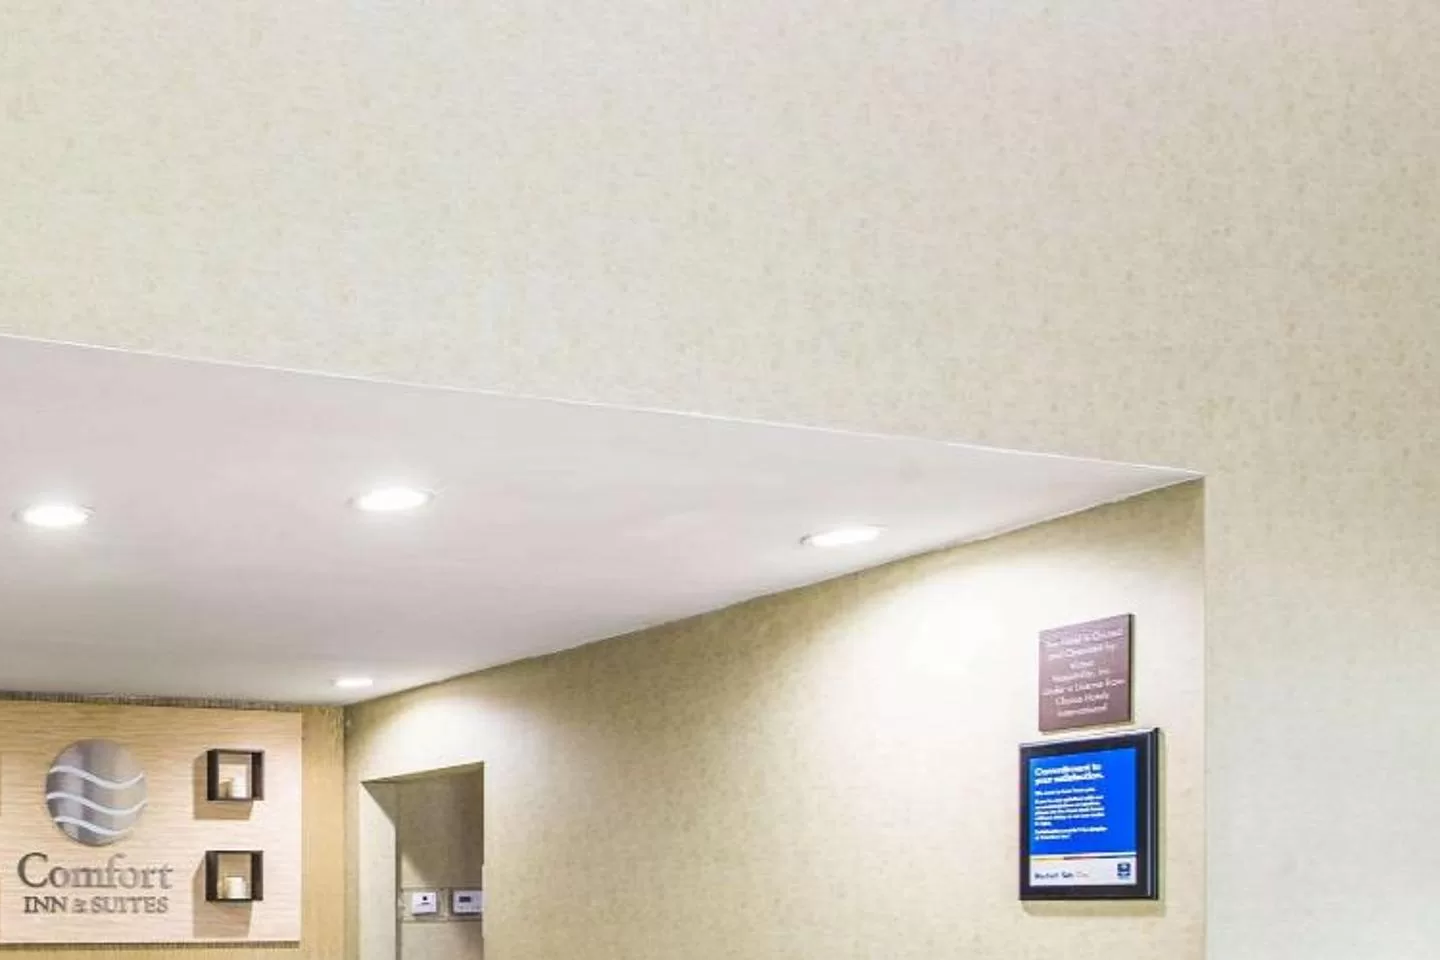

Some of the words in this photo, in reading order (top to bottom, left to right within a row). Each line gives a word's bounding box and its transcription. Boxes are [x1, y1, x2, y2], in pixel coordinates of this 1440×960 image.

[17, 852, 174, 889] Comfort
[23, 896, 68, 914] INN
[91, 896, 169, 914] SUITES
